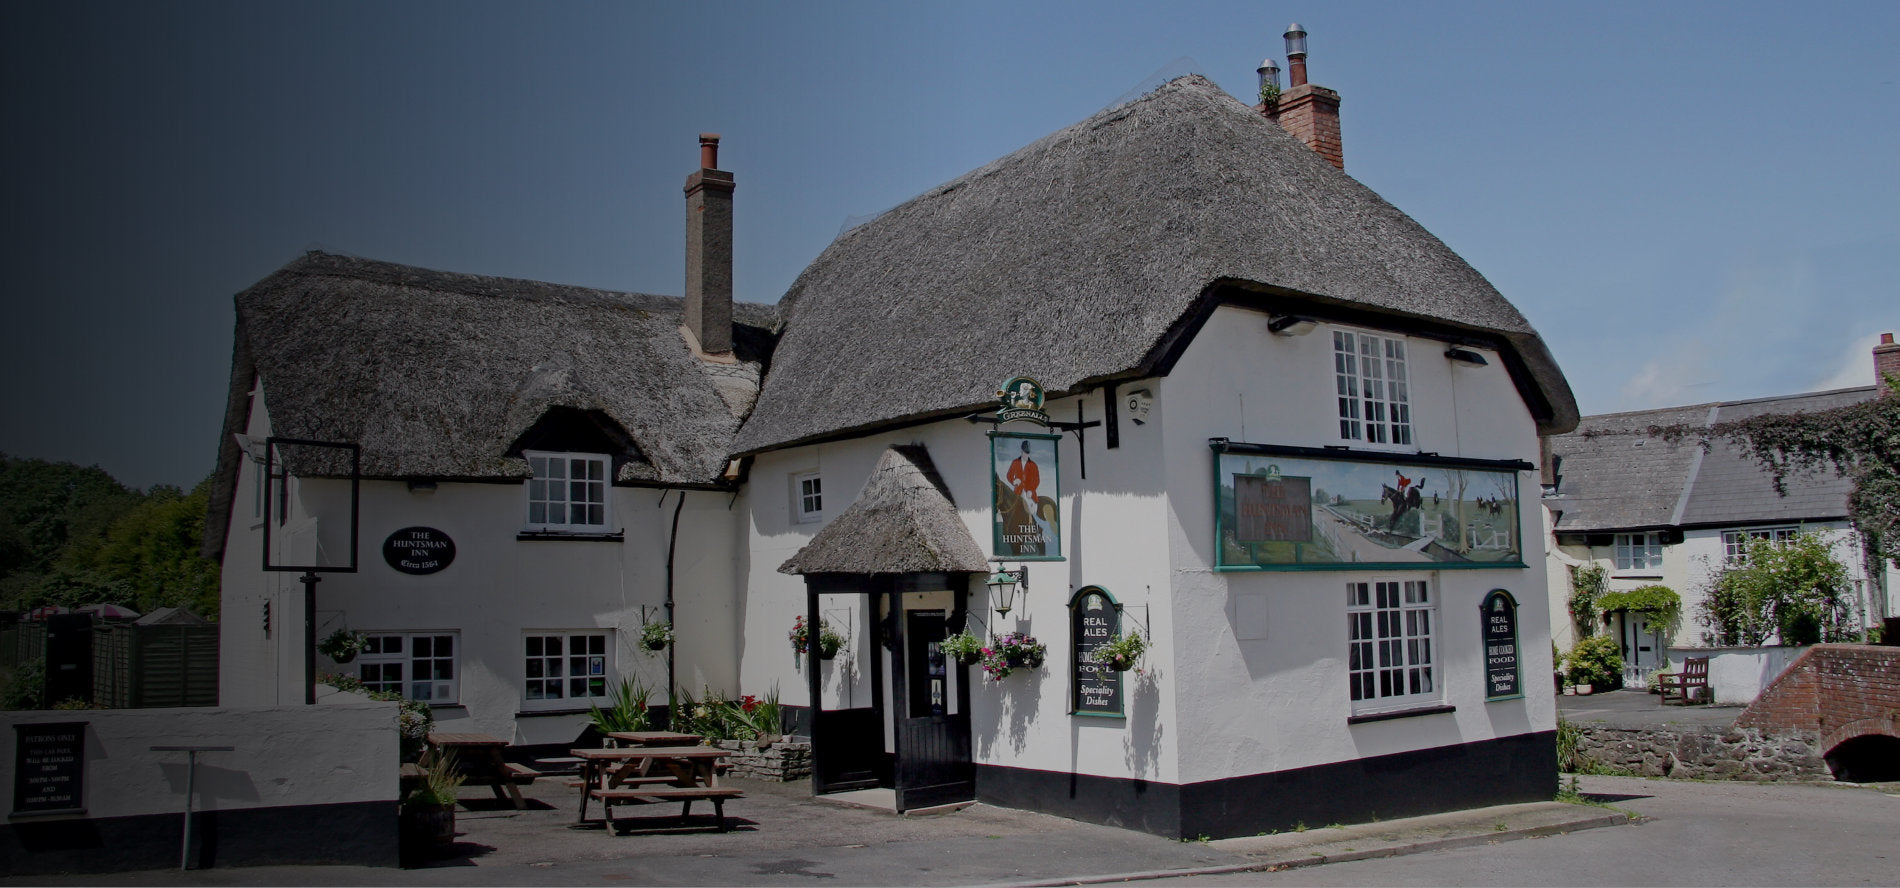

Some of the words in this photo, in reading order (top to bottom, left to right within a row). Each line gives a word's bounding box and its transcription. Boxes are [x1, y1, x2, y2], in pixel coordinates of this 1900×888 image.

[1261, 485, 1287, 498] THE
[1242, 503, 1308, 518] HUNTSMAN
[1018, 524, 1037, 533] THE
[1264, 522, 1287, 535] INN
[411, 531, 430, 539] THE
[1003, 535, 1052, 543] HUNTSMAN
[393, 540, 447, 548] HUNTSMAN
[1020, 544, 1036, 553] INN
[1084, 617, 1107, 625] REAL
[1490, 616, 1508, 624] REAL
[1084, 628, 1108, 637] ALES
[1491, 625, 1508, 633] ALES
[1489, 656, 1515, 664] FOOD
[1491, 672, 1514, 683] Speciality
[1080, 684, 1114, 697] Speciality
[1495, 683, 1511, 691] Dishes
[1086, 696, 1109, 706] Dishes
[25, 735, 55, 743] PATRONS
[57, 734, 75, 742] ONLY
